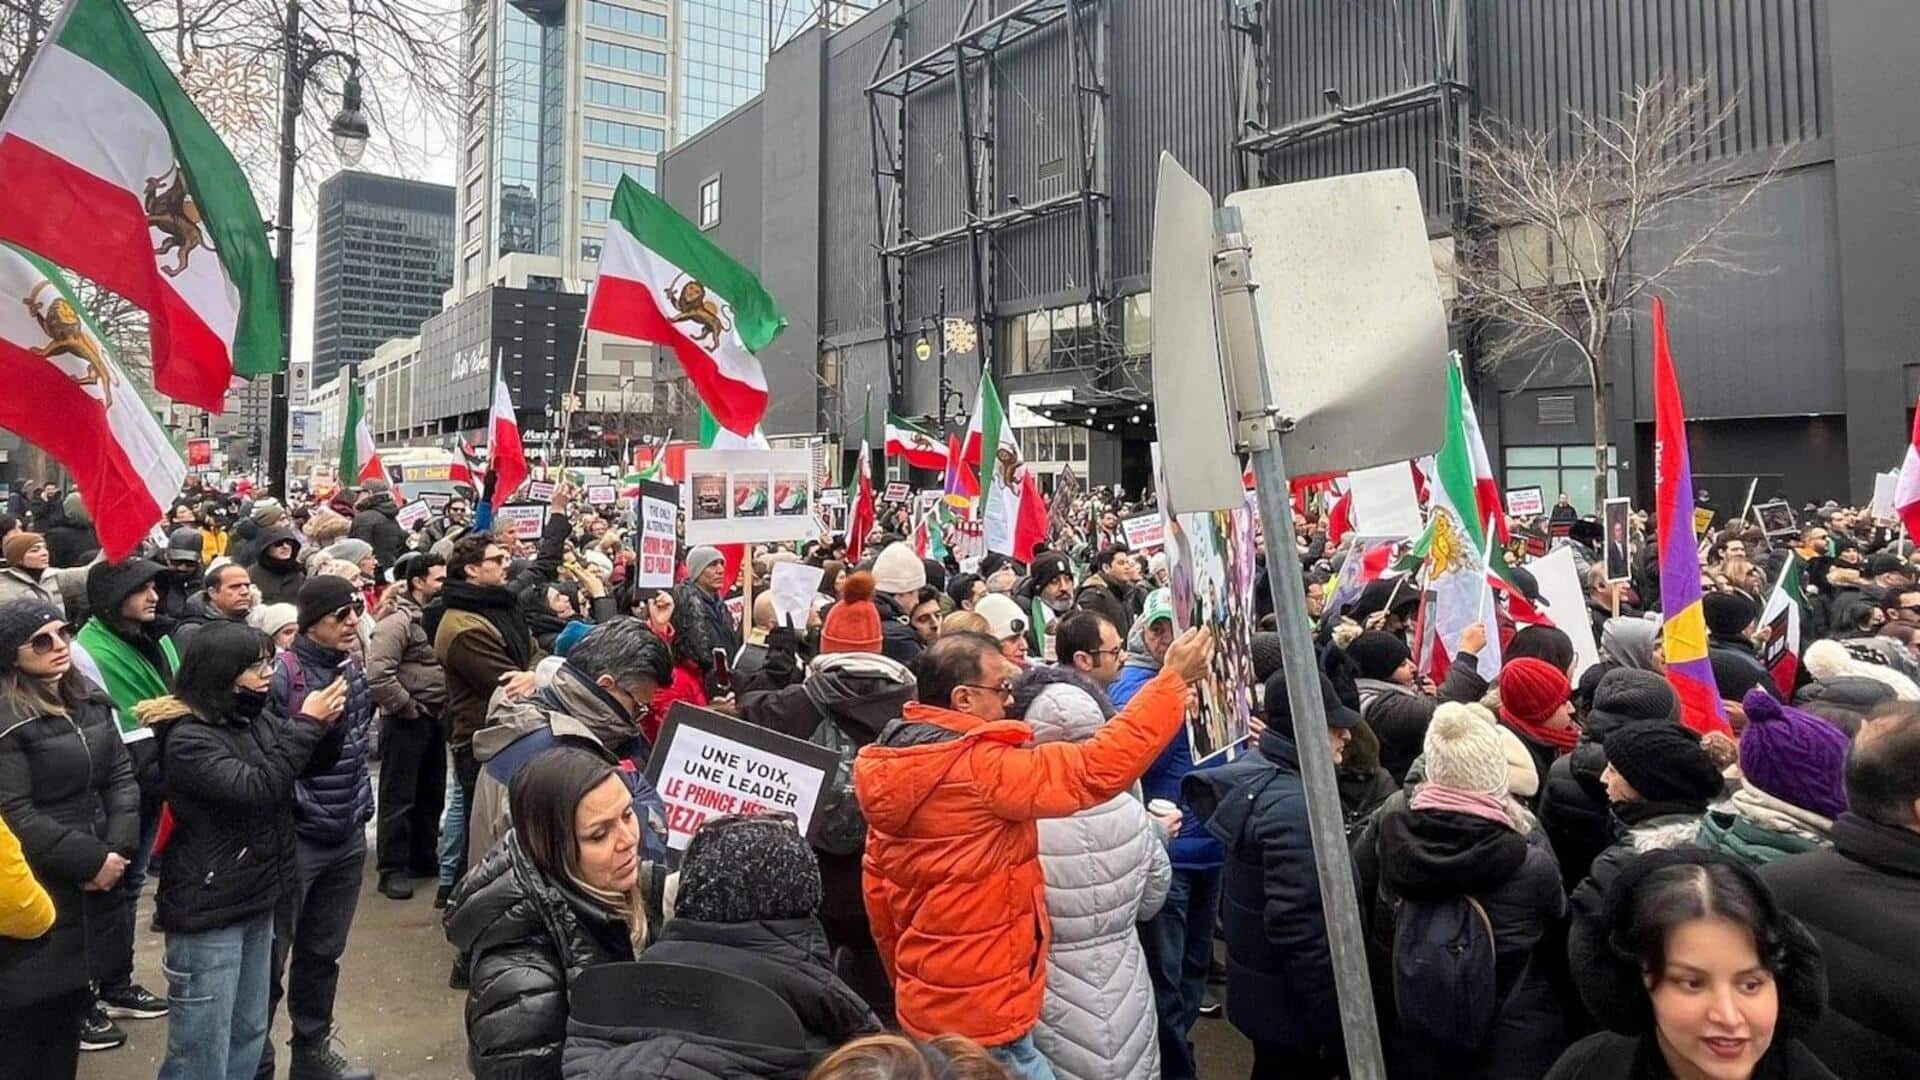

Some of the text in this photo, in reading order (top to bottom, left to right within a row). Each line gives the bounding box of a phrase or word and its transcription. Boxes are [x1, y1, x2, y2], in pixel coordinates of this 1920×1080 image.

[684, 760, 798, 807] UNE LEADER
[702, 745, 791, 788] UNE VOIX,
[665, 777, 684, 798] LE
[685, 783, 738, 815] PRINCE
